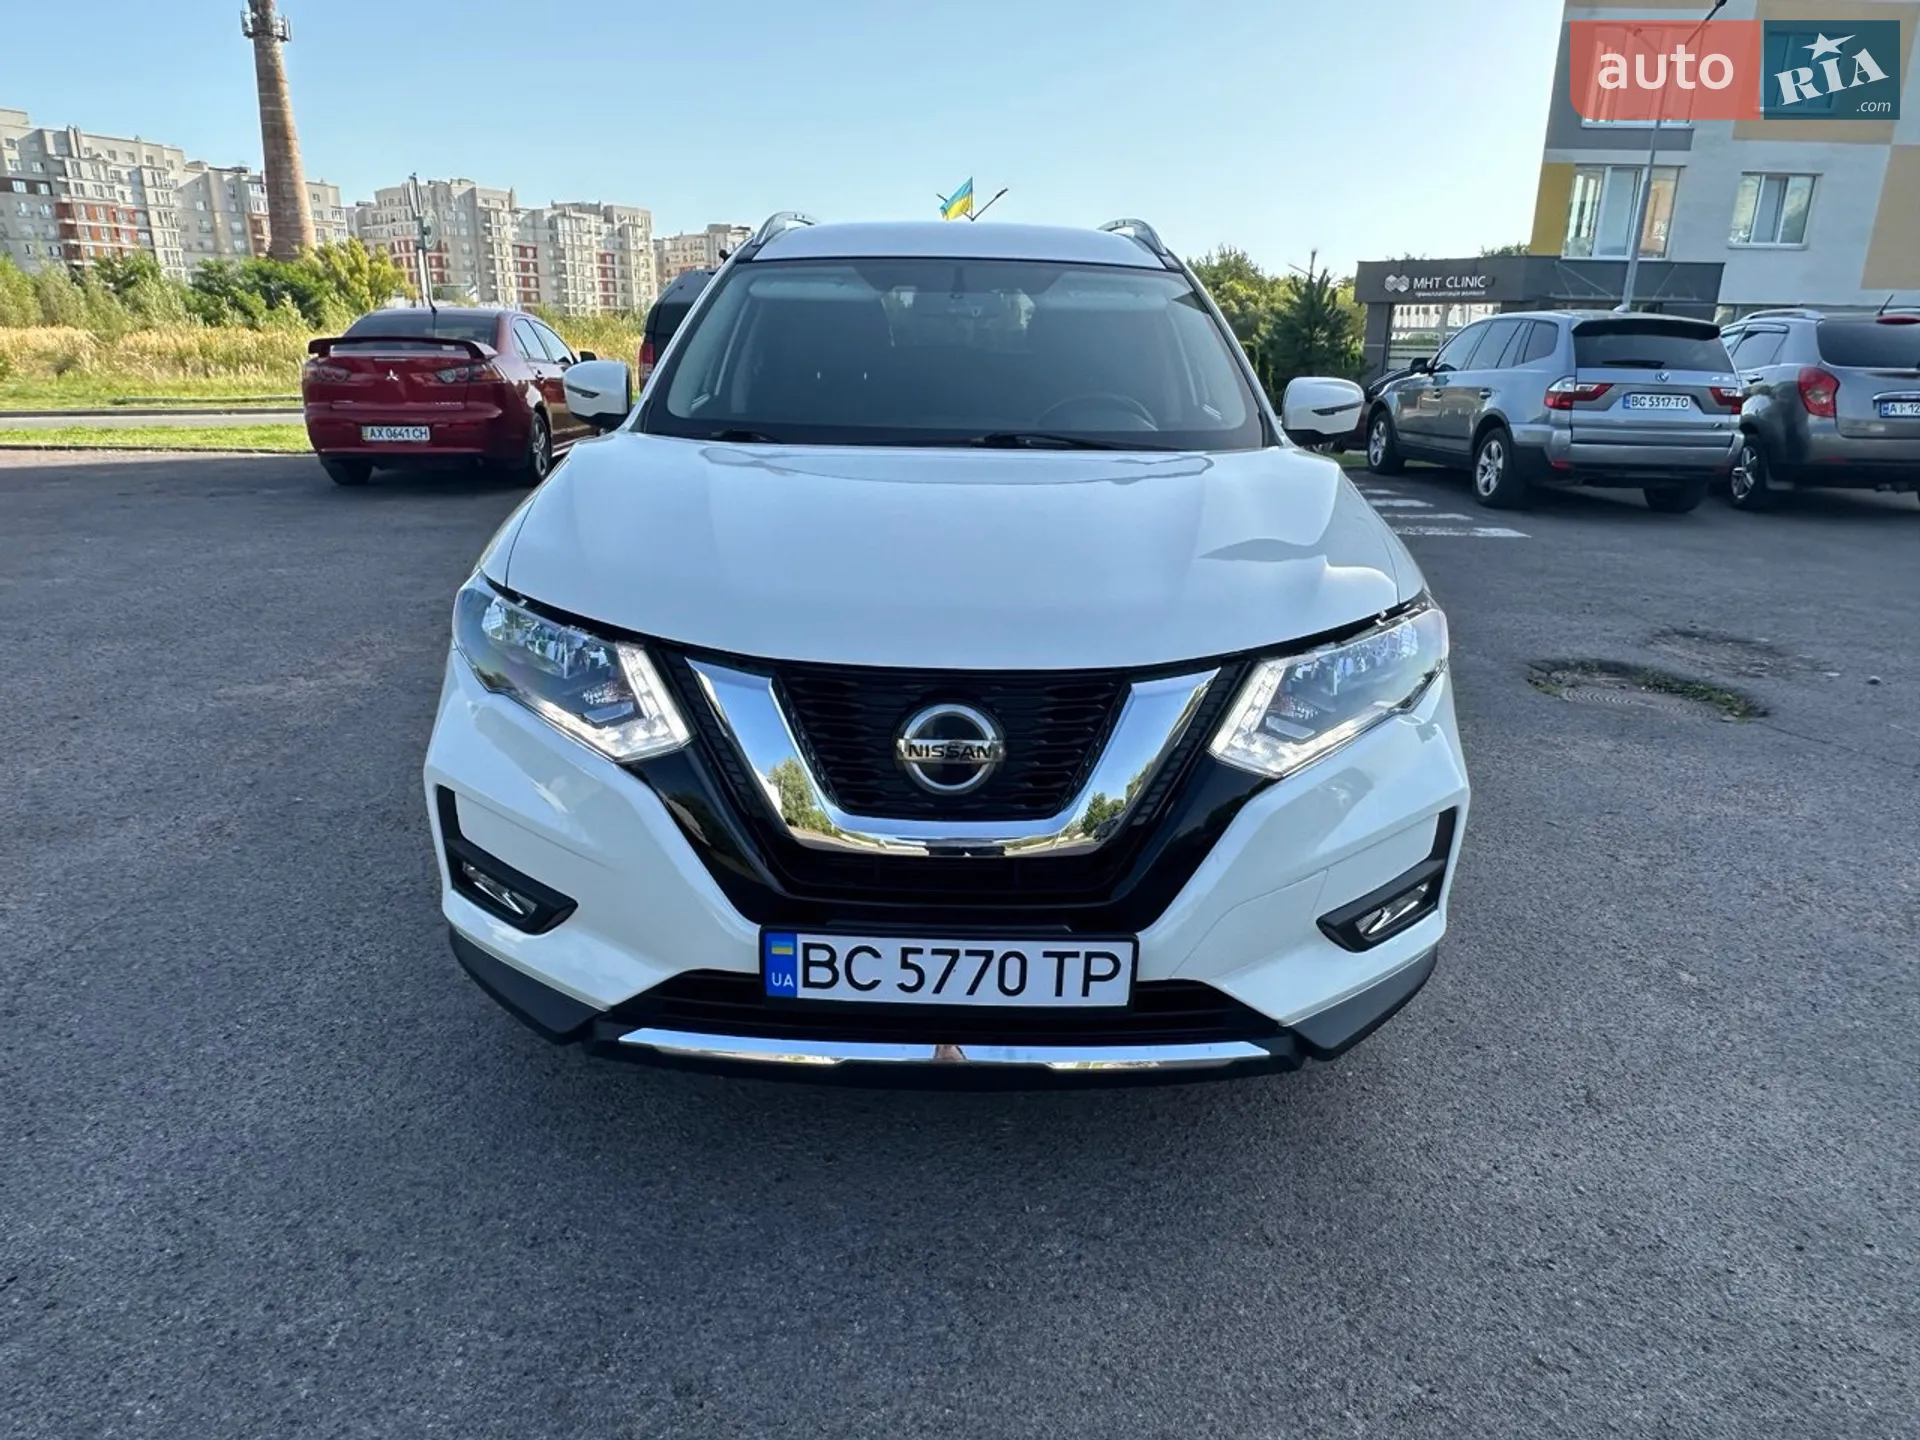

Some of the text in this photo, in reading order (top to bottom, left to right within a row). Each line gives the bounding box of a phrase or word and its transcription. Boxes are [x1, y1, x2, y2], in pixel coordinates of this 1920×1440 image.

[1413, 276, 1486, 289] MHT CLINIC
[370, 427, 383, 438] AX
[908, 744, 992, 759] NISSAN
[801, 942, 1122, 998] BC 5770 TP
[771, 971, 795, 988] UA
